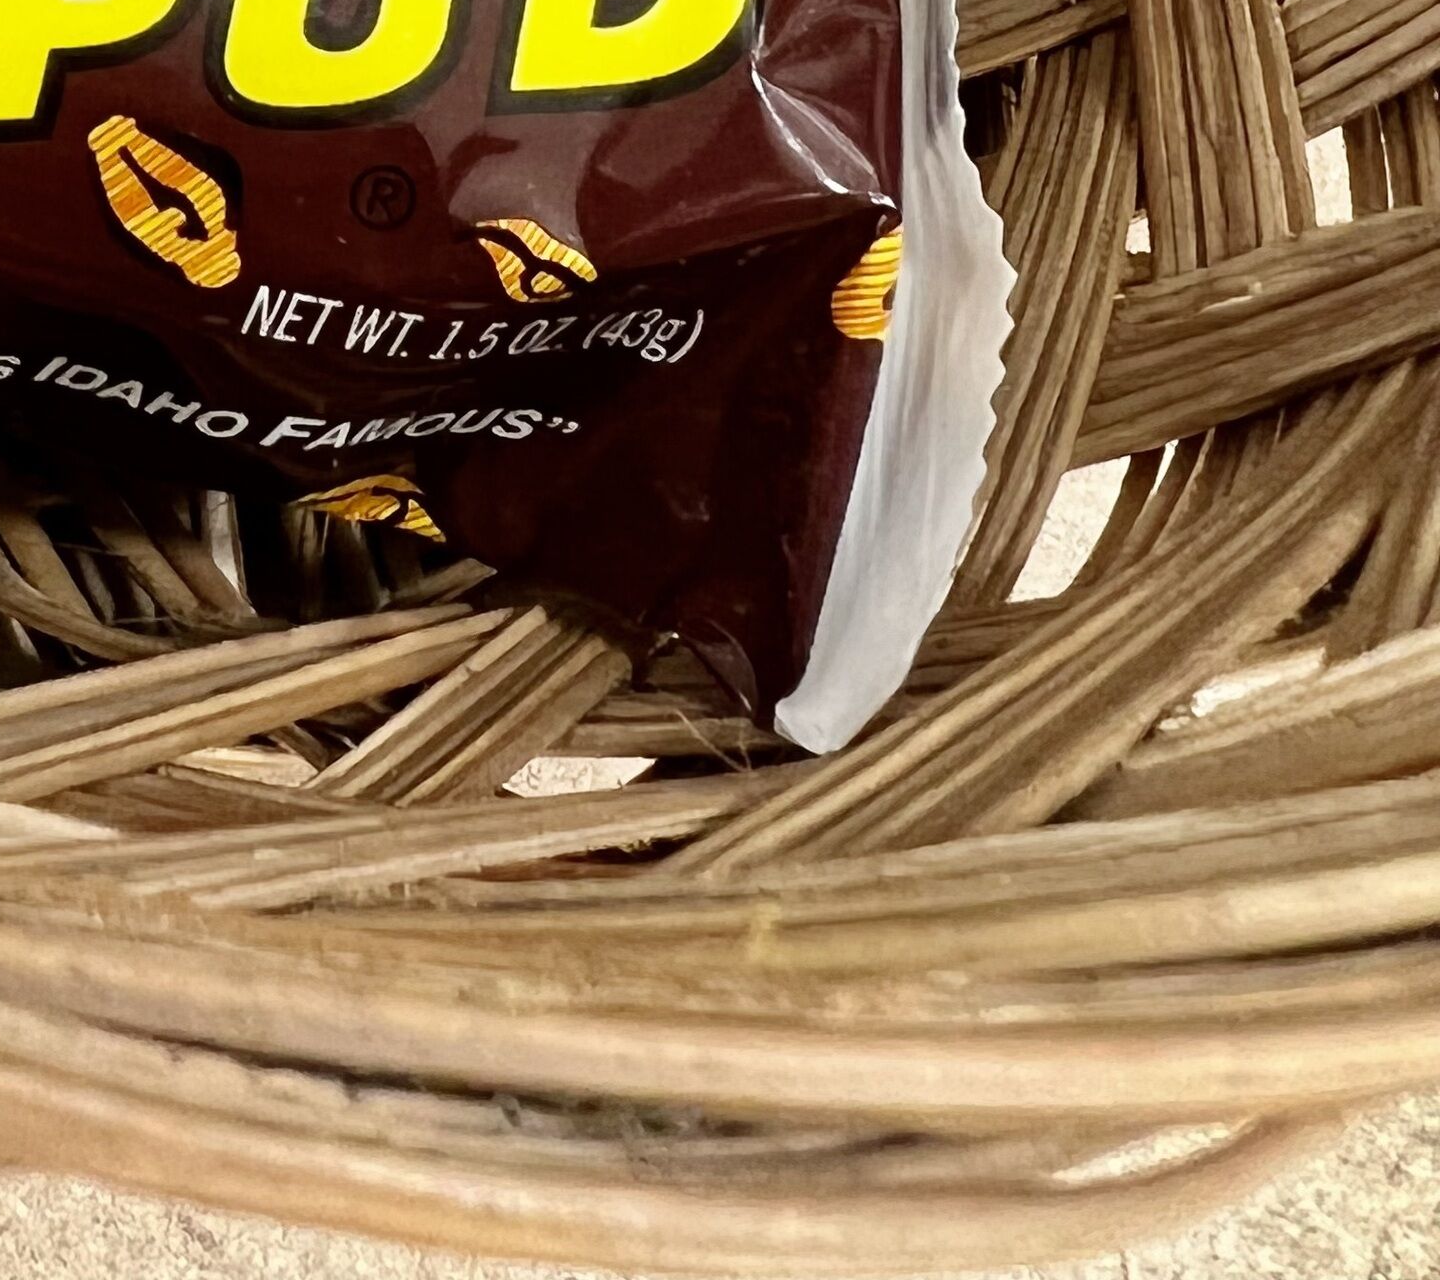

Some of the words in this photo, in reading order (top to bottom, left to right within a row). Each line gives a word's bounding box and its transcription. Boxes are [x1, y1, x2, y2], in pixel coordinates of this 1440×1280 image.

[240, 284, 345, 346] NET
[343, 304, 426, 358] WT.
[427, 320, 509, 361] 1.5
[580, 308, 705, 364] (43g)
[31, 355, 251, 440] IDAHO
